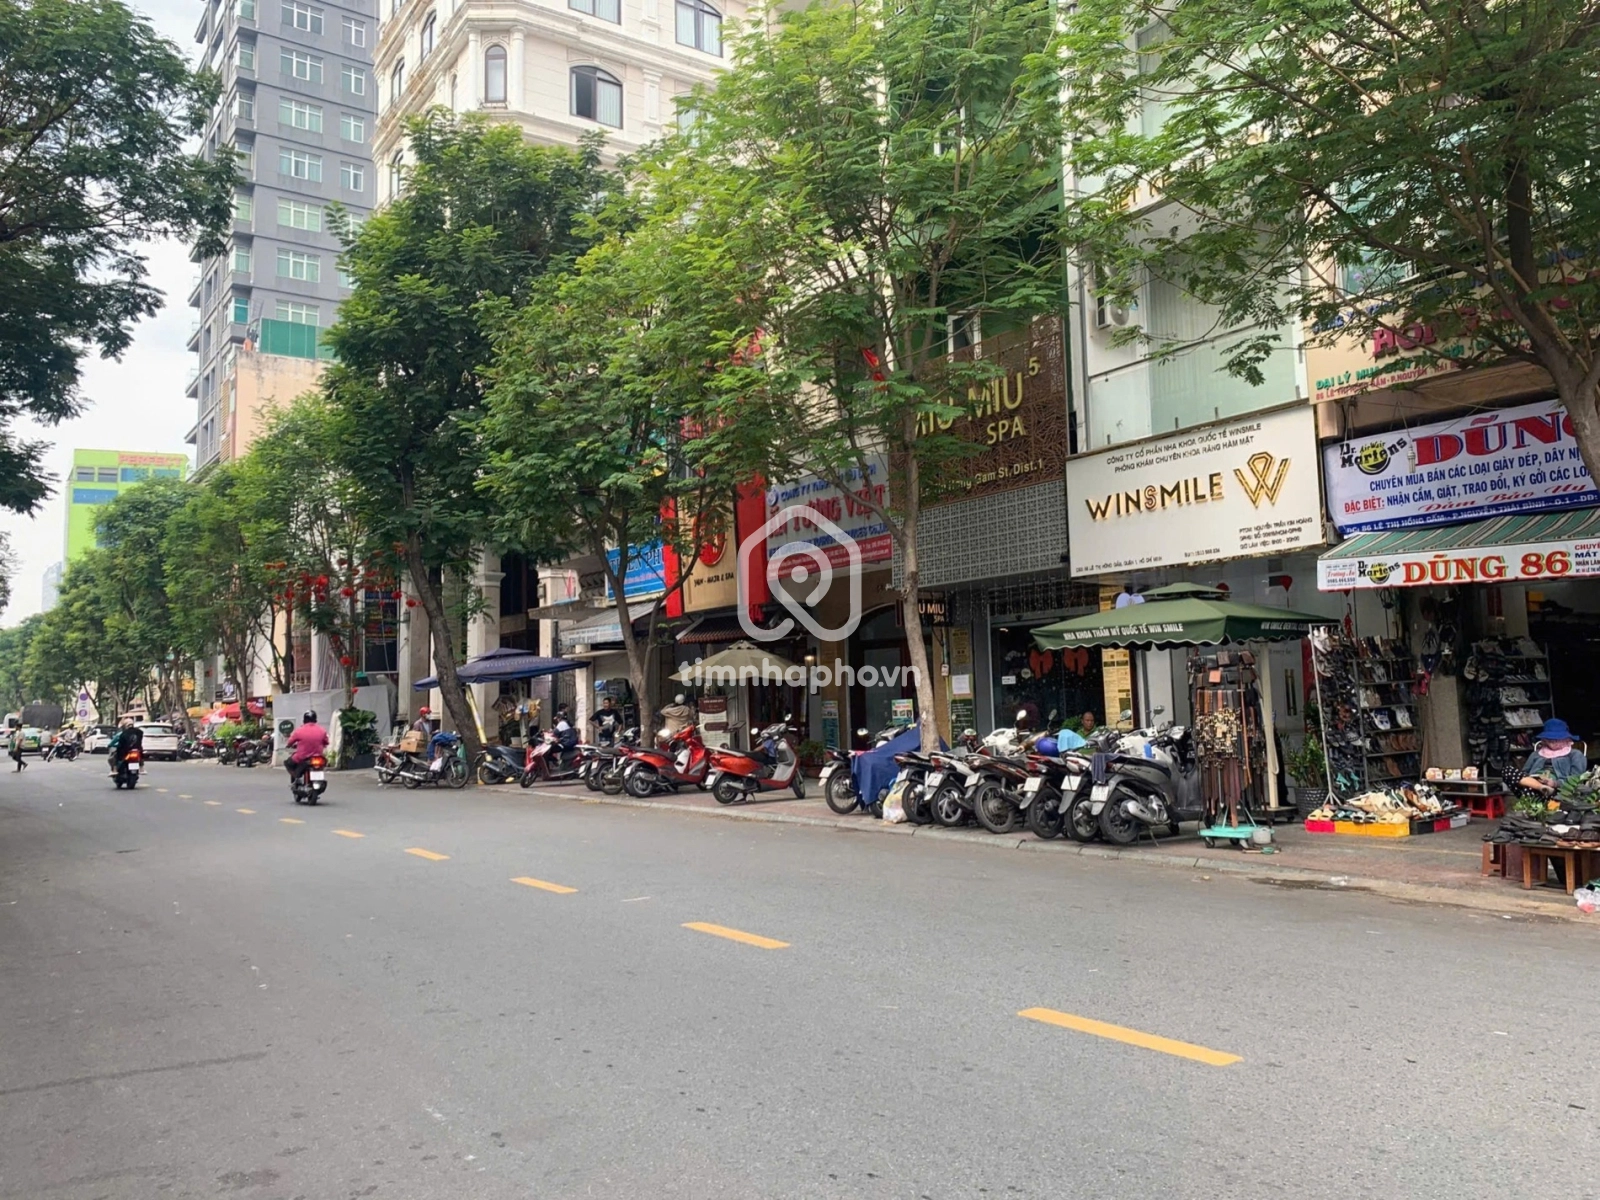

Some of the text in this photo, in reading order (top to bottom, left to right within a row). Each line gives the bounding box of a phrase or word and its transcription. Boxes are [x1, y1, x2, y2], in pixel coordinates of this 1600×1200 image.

[967, 372, 1023, 421] MIU
[1028, 356, 1041, 376] 5
[986, 415, 1025, 445] SPA
[1125, 452, 1134, 461] TY
[1163, 442, 1177, 454] NHA
[1178, 438, 1196, 449] KHOA
[1198, 429, 1217, 444] QUỐC
[1218, 426, 1227, 439] TẾ
[1228, 423, 1262, 437] WINSMILE
[1183, 448, 1201, 458] KHOA
[1339, 442, 1357, 456] Dr.
[1341, 438, 1407, 469] Martens
[1370, 475, 1403, 492] CHUYÊN
[1406, 473, 1425, 486] MUA
[1427, 467, 1446, 482] BÁN
[1448, 464, 1467, 479] CÁC
[1469, 461, 1490, 478] LOẠI
[1493, 456, 1514, 471] GIÀY
[1545, 447, 1565, 463] DÂY
[1569, 447, 1581, 461] NỊ
[1085, 472, 1224, 521] WINSMILE
[1344, 500, 1360, 515] ĐẶC
[1363, 496, 1385, 511] BIỆT:
[1387, 491, 1410, 507] NHẬN
[1462, 480, 1488, 495] TRAO
[1512, 471, 1526, 487] KÝ
[1549, 466, 1570, 482] CÁC
[1374, 521, 1384, 530] LÊ
[1403, 551, 1573, 583] DŨNG 86
[1063, 632, 1076, 640] NHA
[1076, 630, 1093, 640] KHOA
[1148, 624, 1162, 633] WIN
[1163, 623, 1184, 633] SMILE
